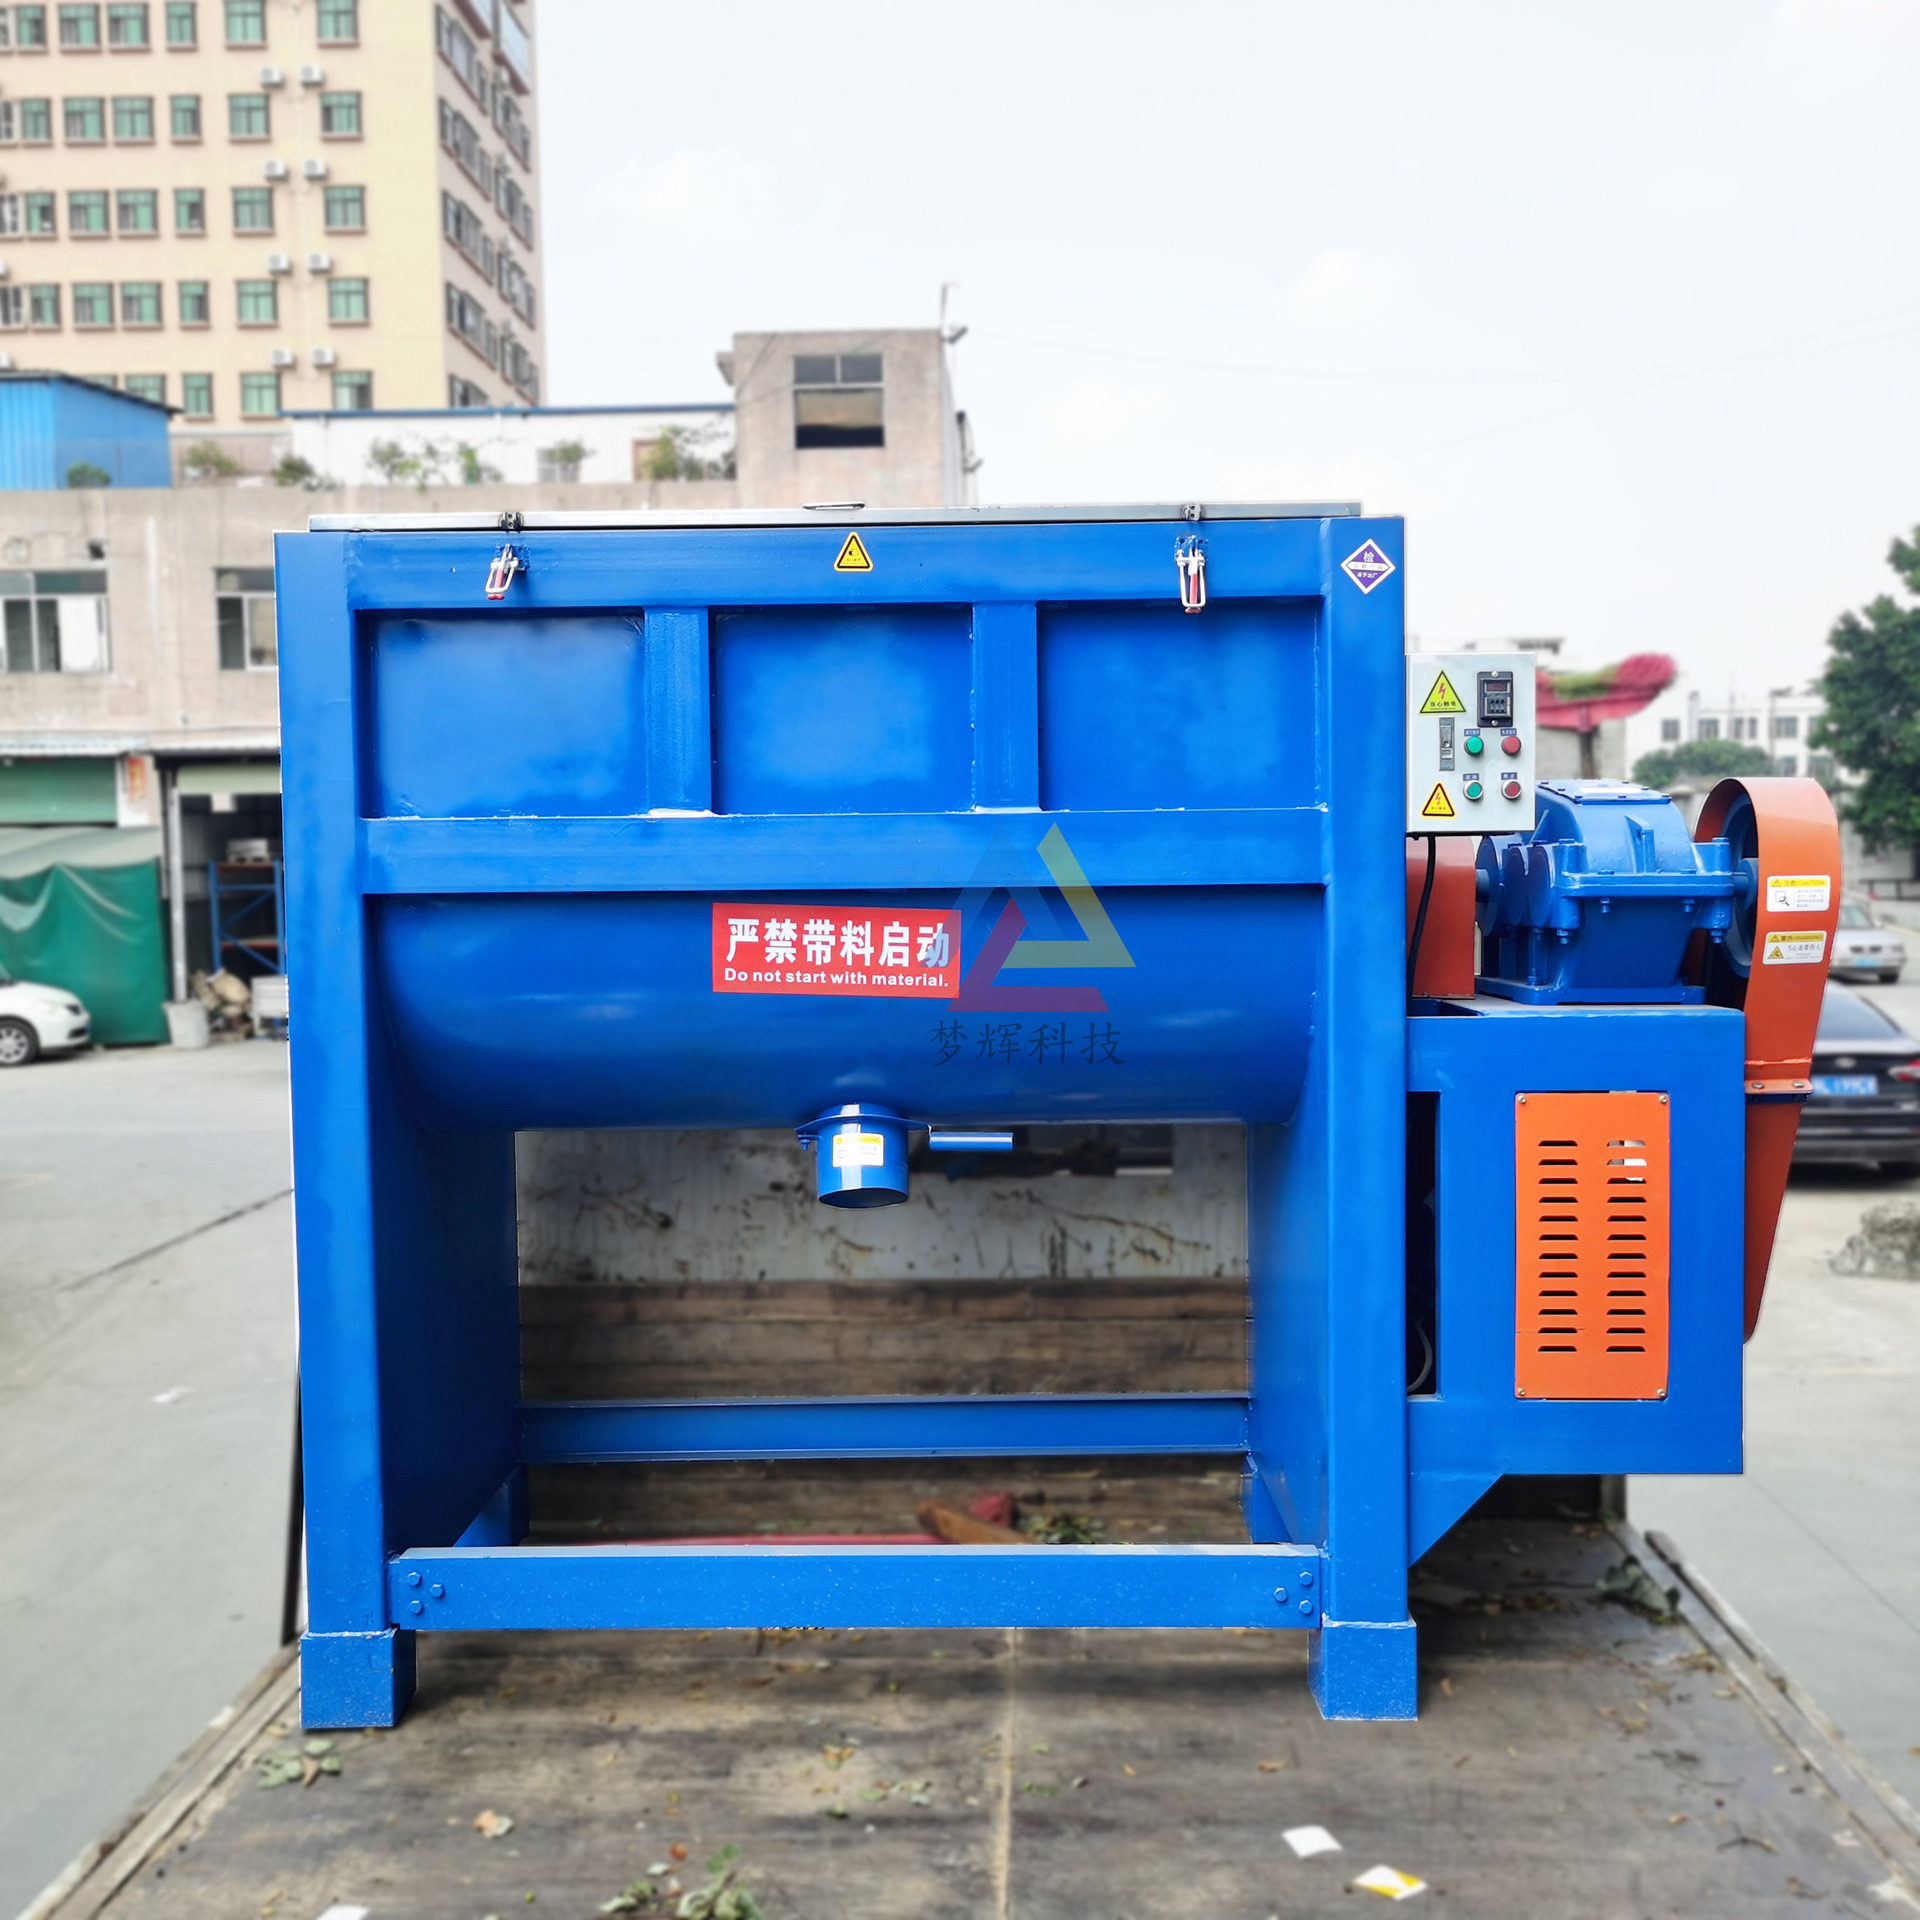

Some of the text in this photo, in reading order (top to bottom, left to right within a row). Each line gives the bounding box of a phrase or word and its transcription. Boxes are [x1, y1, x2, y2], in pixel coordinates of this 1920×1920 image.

[725, 918, 950, 968] 严禁带料启动
[724, 968, 949, 987] Do not start with material.
